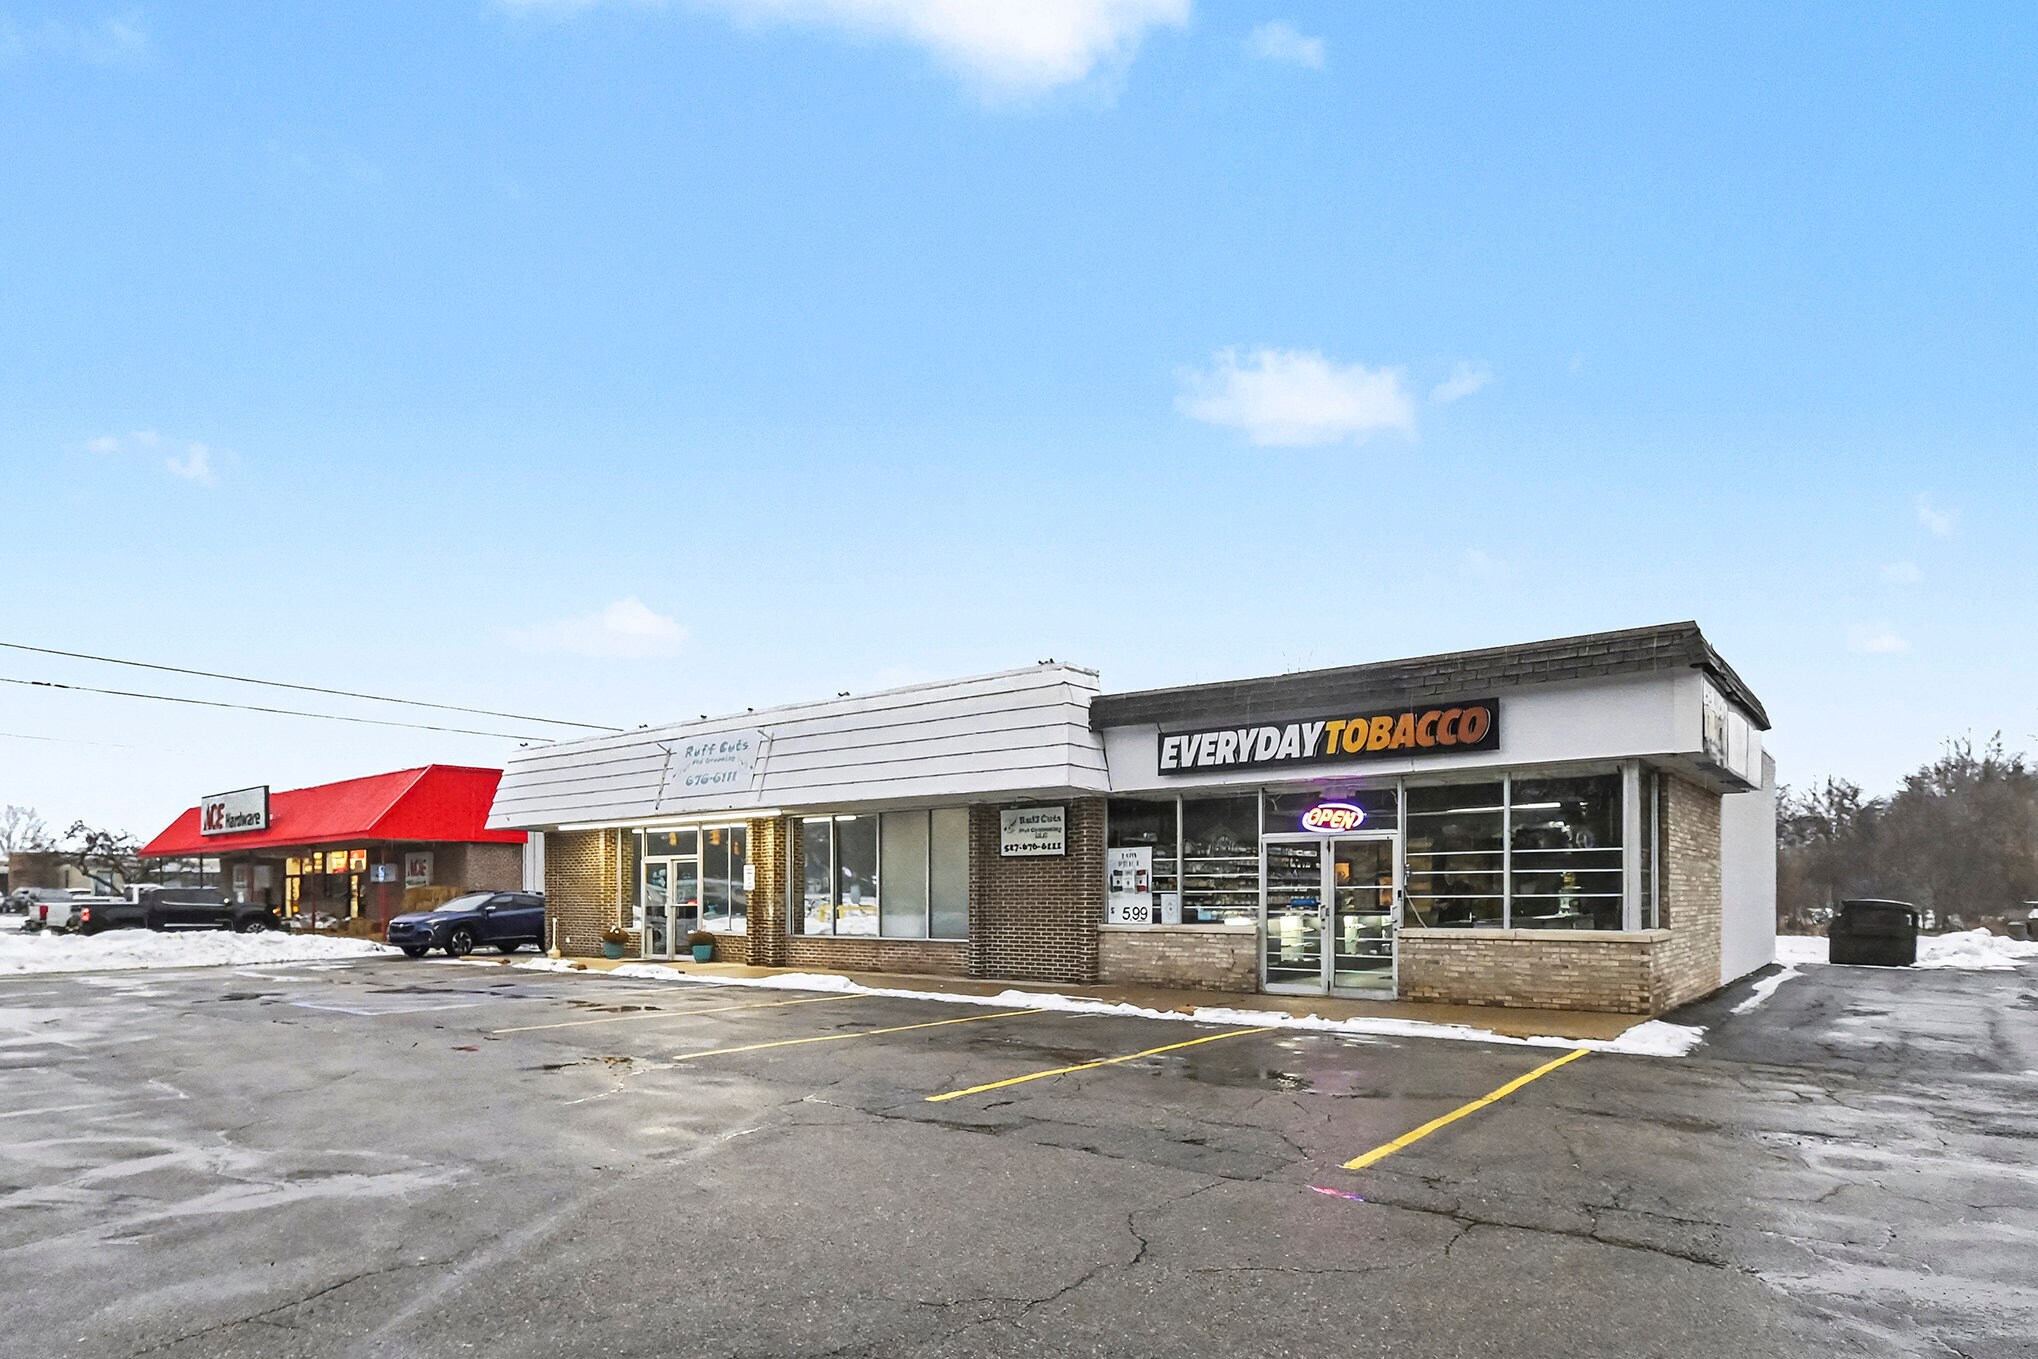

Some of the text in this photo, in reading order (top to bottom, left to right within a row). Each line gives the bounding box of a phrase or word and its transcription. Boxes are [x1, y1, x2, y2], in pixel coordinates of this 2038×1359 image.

[685, 740, 749, 758] Ruff Cuts
[685, 771, 738, 786] 676-6111
[203, 803, 261, 831] ACE Hardware
[1307, 807, 1357, 830] OPEN
